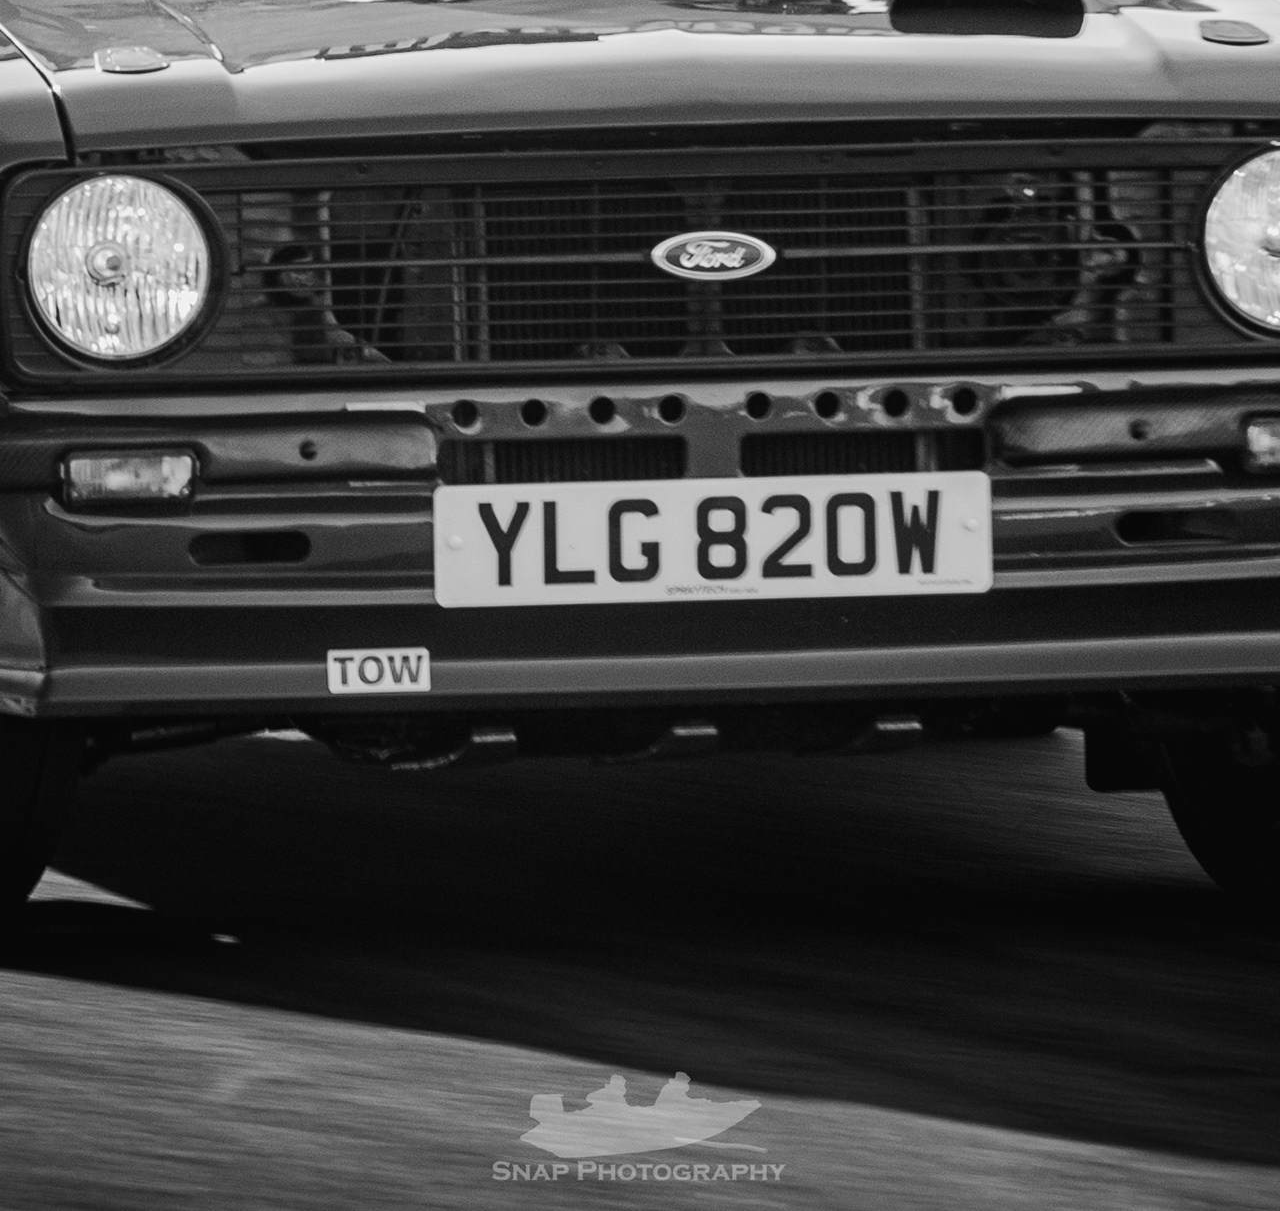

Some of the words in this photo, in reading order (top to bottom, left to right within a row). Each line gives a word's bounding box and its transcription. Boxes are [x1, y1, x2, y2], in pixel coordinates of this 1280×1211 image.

[679, 240, 747, 269] Ford
[478, 498, 660, 587] YLG
[696, 489, 940, 581] 820W
[333, 655, 423, 685] TOW
